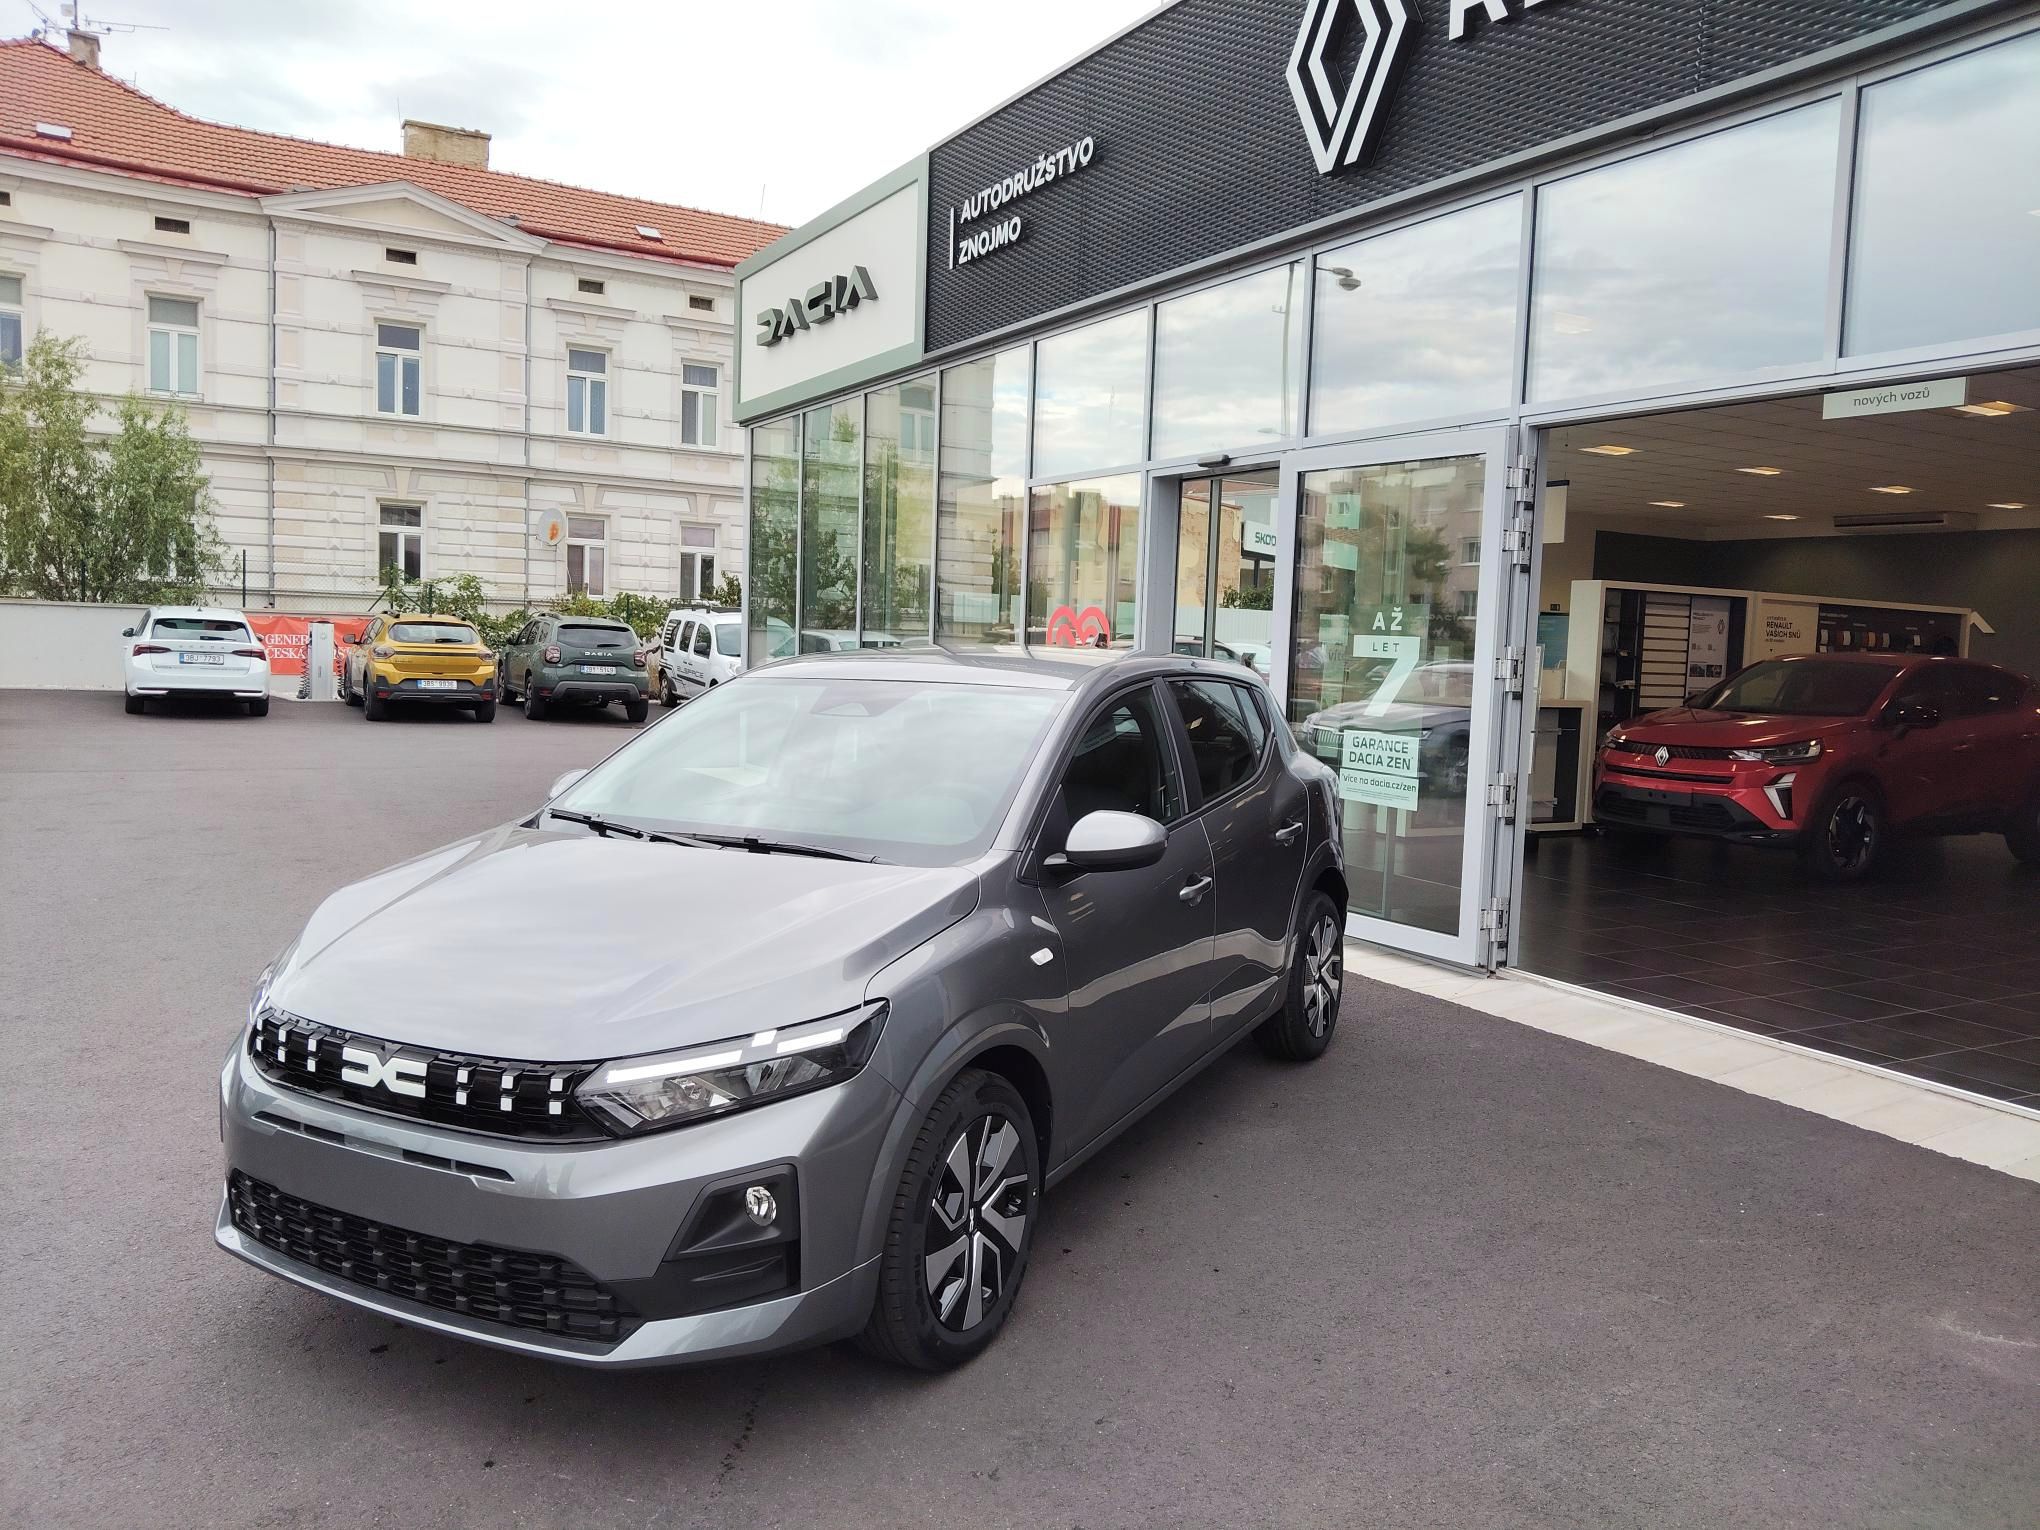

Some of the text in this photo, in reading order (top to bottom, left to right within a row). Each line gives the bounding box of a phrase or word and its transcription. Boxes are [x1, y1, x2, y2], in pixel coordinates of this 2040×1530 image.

[960, 136, 1095, 224] AUTODRUŽSTVO
[959, 216, 1022, 265] ZNOJMO
[756, 264, 879, 347] DACIA
[1853, 386, 1930, 407] nových vozů
[1372, 606, 1403, 631] AŽ
[1766, 621, 1793, 630] RENAULT
[266, 645, 306, 659] ČESKÁ
[1372, 642, 1400, 653] LET
[1352, 634, 1421, 718] 7
[1352, 736, 1409, 754] GARANCE
[1349, 751, 1384, 767] DACIA
[1359, 776, 1369, 785] na
[1370, 779, 1417, 793] dacia.cz/zen
